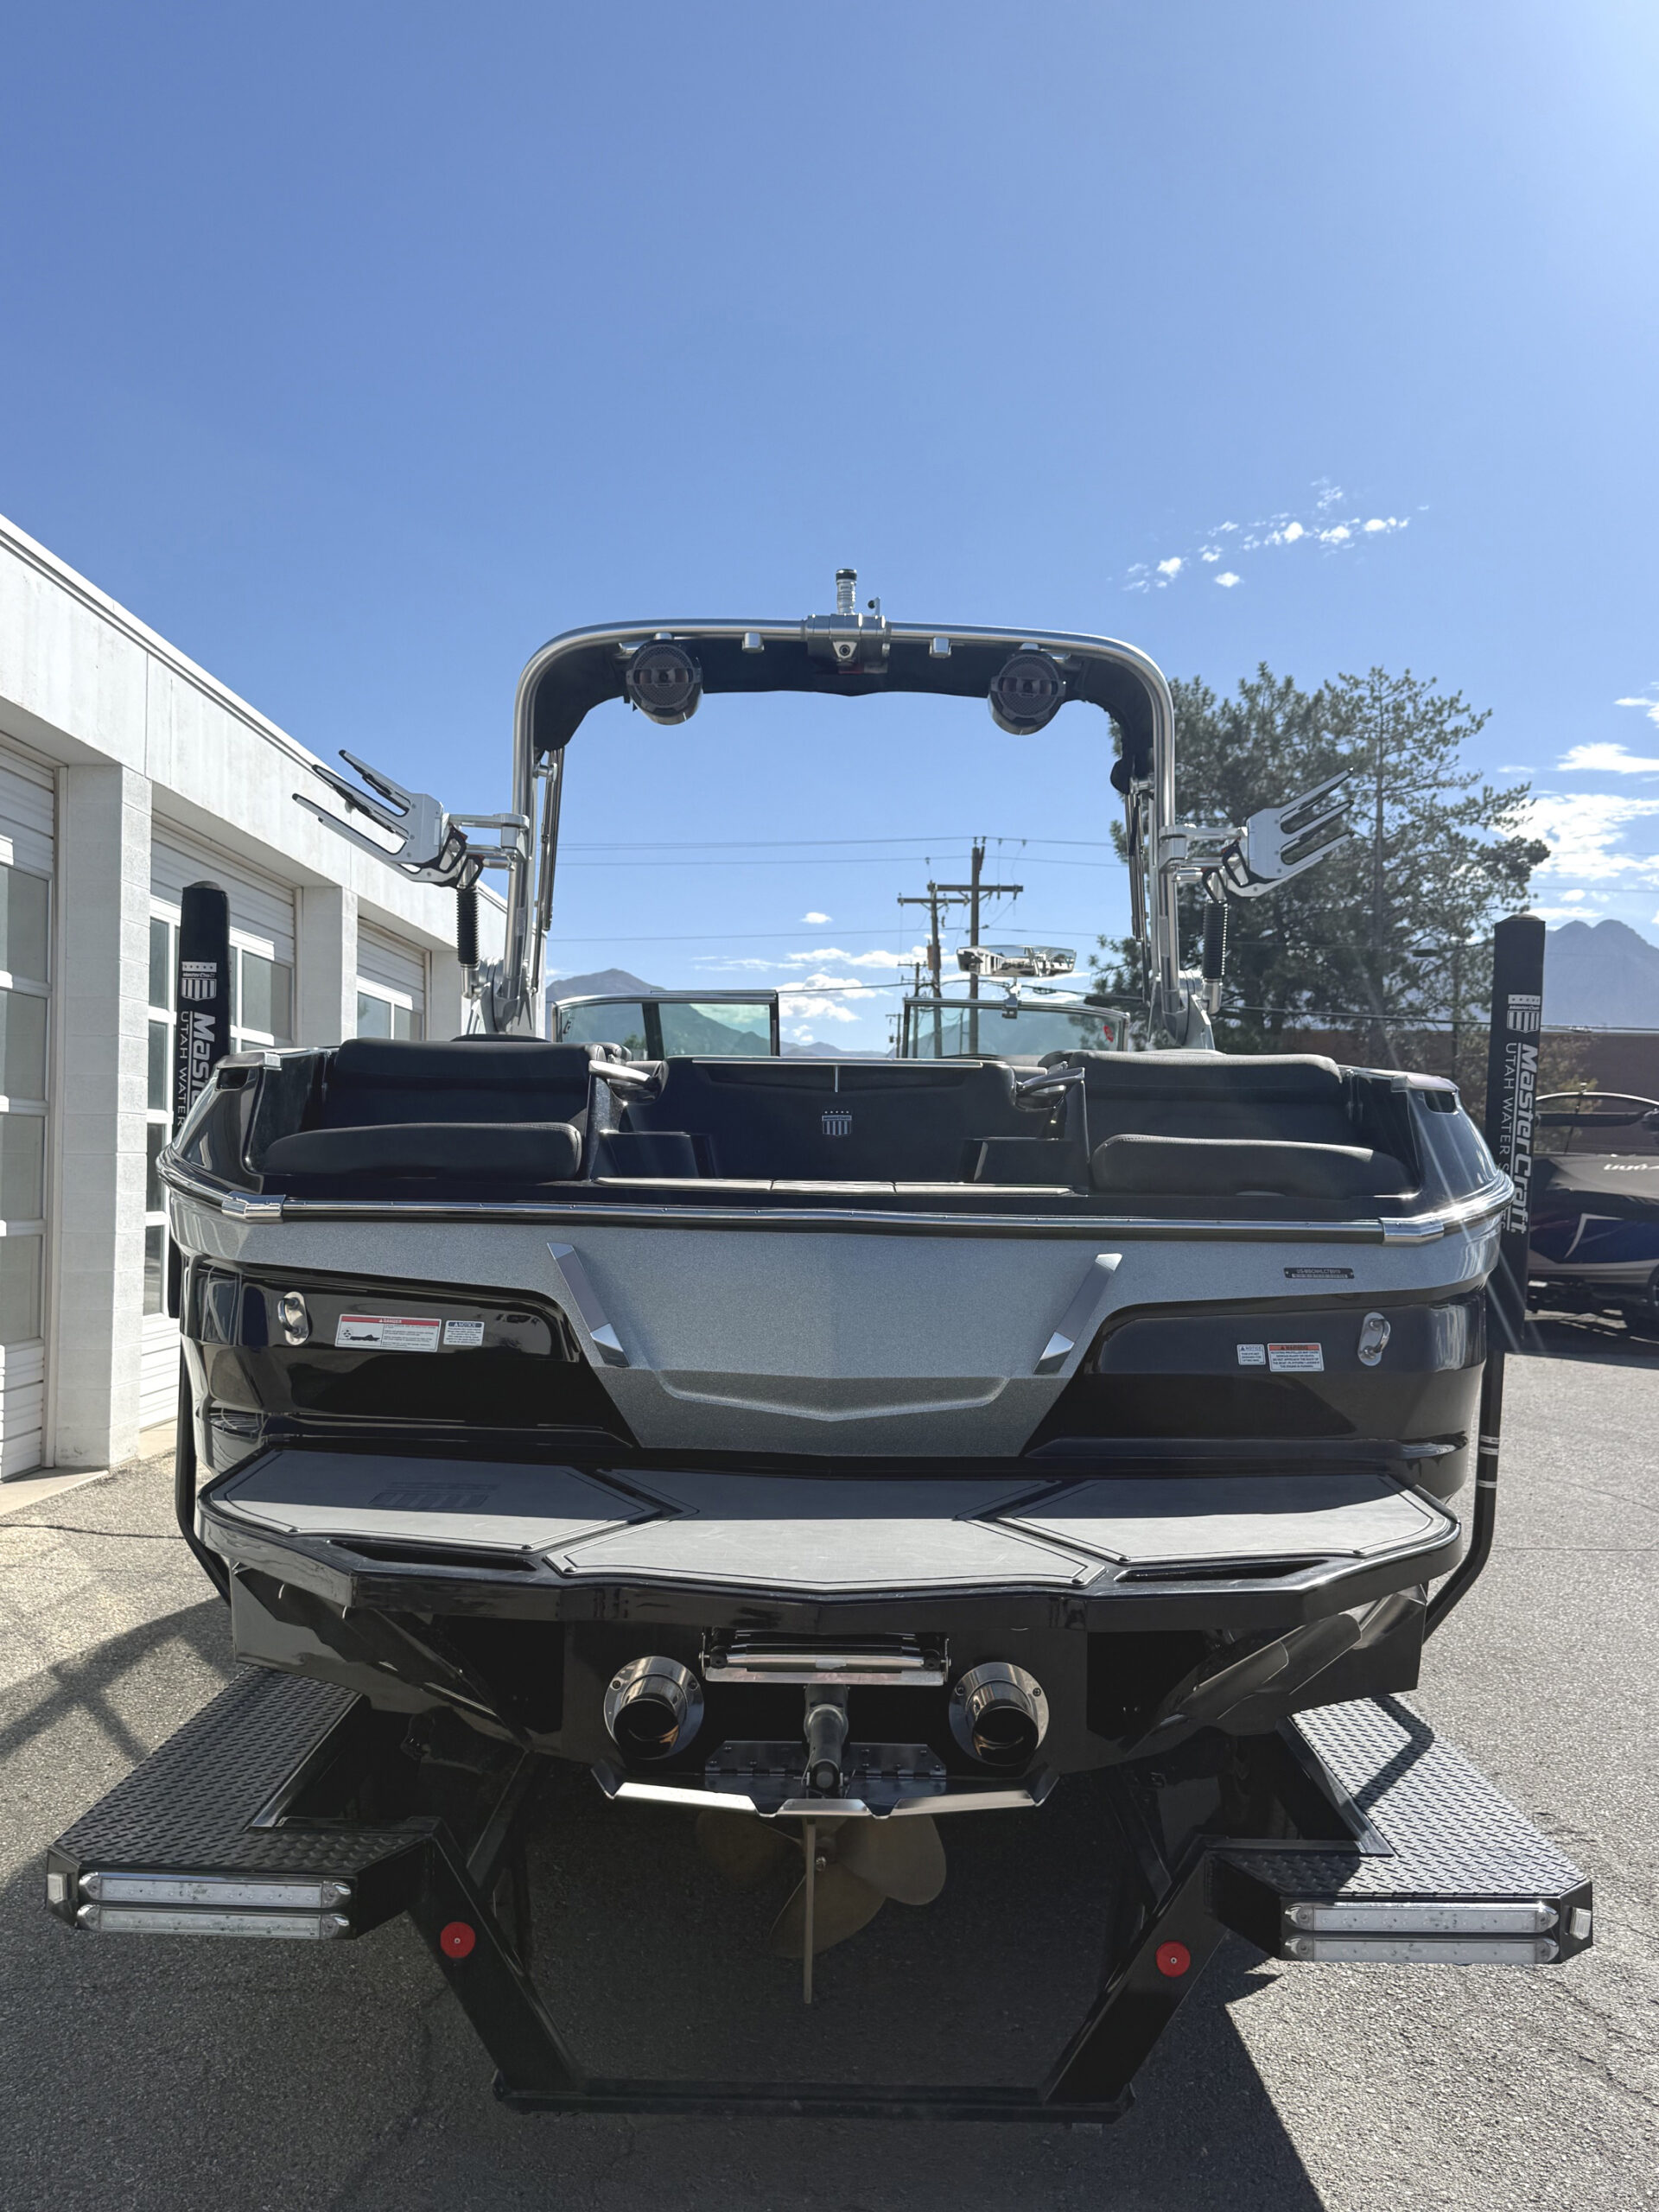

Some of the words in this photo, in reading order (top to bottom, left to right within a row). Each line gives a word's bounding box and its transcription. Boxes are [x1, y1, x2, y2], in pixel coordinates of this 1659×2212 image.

[180, 1011, 189, 1058] UTAH
[1504, 1043, 1517, 1090] UTAH
[177, 1066, 188, 1126] WATER
[1499, 1097, 1514, 1155] WATER
[1511, 1044, 1538, 1234] MasterCraft
